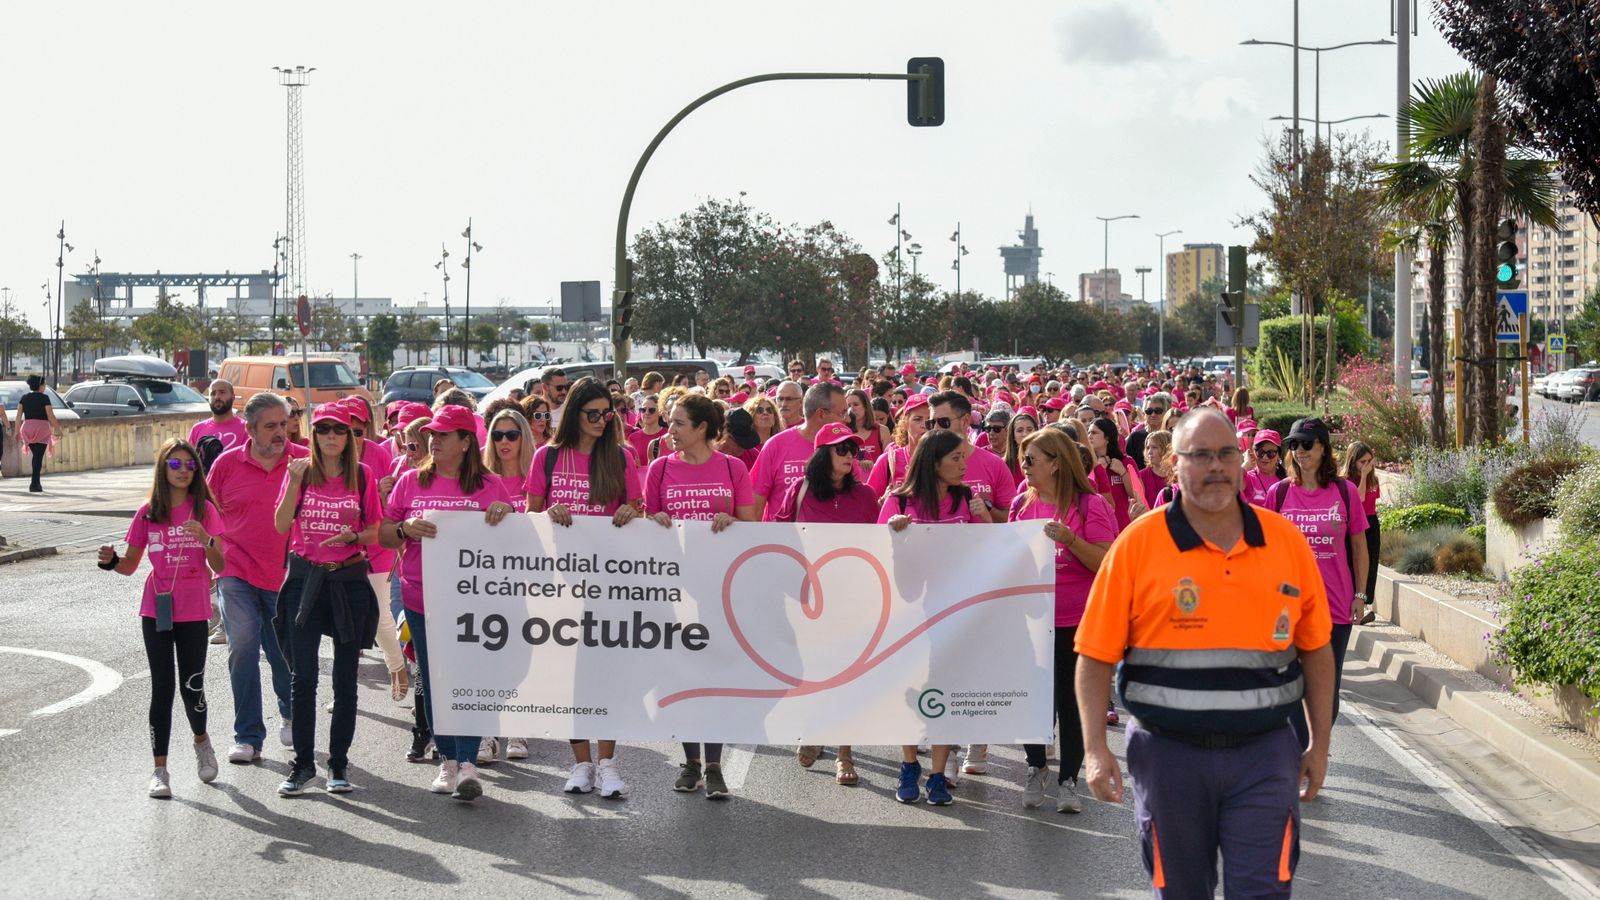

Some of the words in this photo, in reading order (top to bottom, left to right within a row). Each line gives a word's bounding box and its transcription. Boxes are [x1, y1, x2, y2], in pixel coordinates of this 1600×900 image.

[784, 464, 799, 474] En
[552, 476, 566, 487] En
[551, 489, 590, 500] contra
[667, 488, 682, 499] En
[685, 486, 732, 497] marcha
[411, 499, 425, 508] En
[428, 499, 479, 509] marcha
[667, 498, 710, 511] contra
[301, 509, 339, 519] contra
[683, 510, 718, 520] cánc
[1296, 510, 1341, 521] marcha
[1306, 536, 1334, 545] ncer
[459, 549, 495, 570] Día
[502, 552, 599, 573] mundial
[605, 557, 680, 576] contra
[457, 575, 479, 595] el
[484, 577, 566, 598] cáncer
[571, 579, 602, 599] de
[608, 585, 682, 602] mama
[456, 612, 509, 651] 19
[522, 611, 710, 651] octubre
[452, 688, 473, 698] 900
[476, 689, 495, 698] 100
[498, 688, 518, 700] 036
[950, 690, 992, 698] asociación
[993, 690, 1028, 699] española
[451, 701, 608, 716] asociacioncontraelcancer.es
[962, 709, 997, 717] Algeciras
